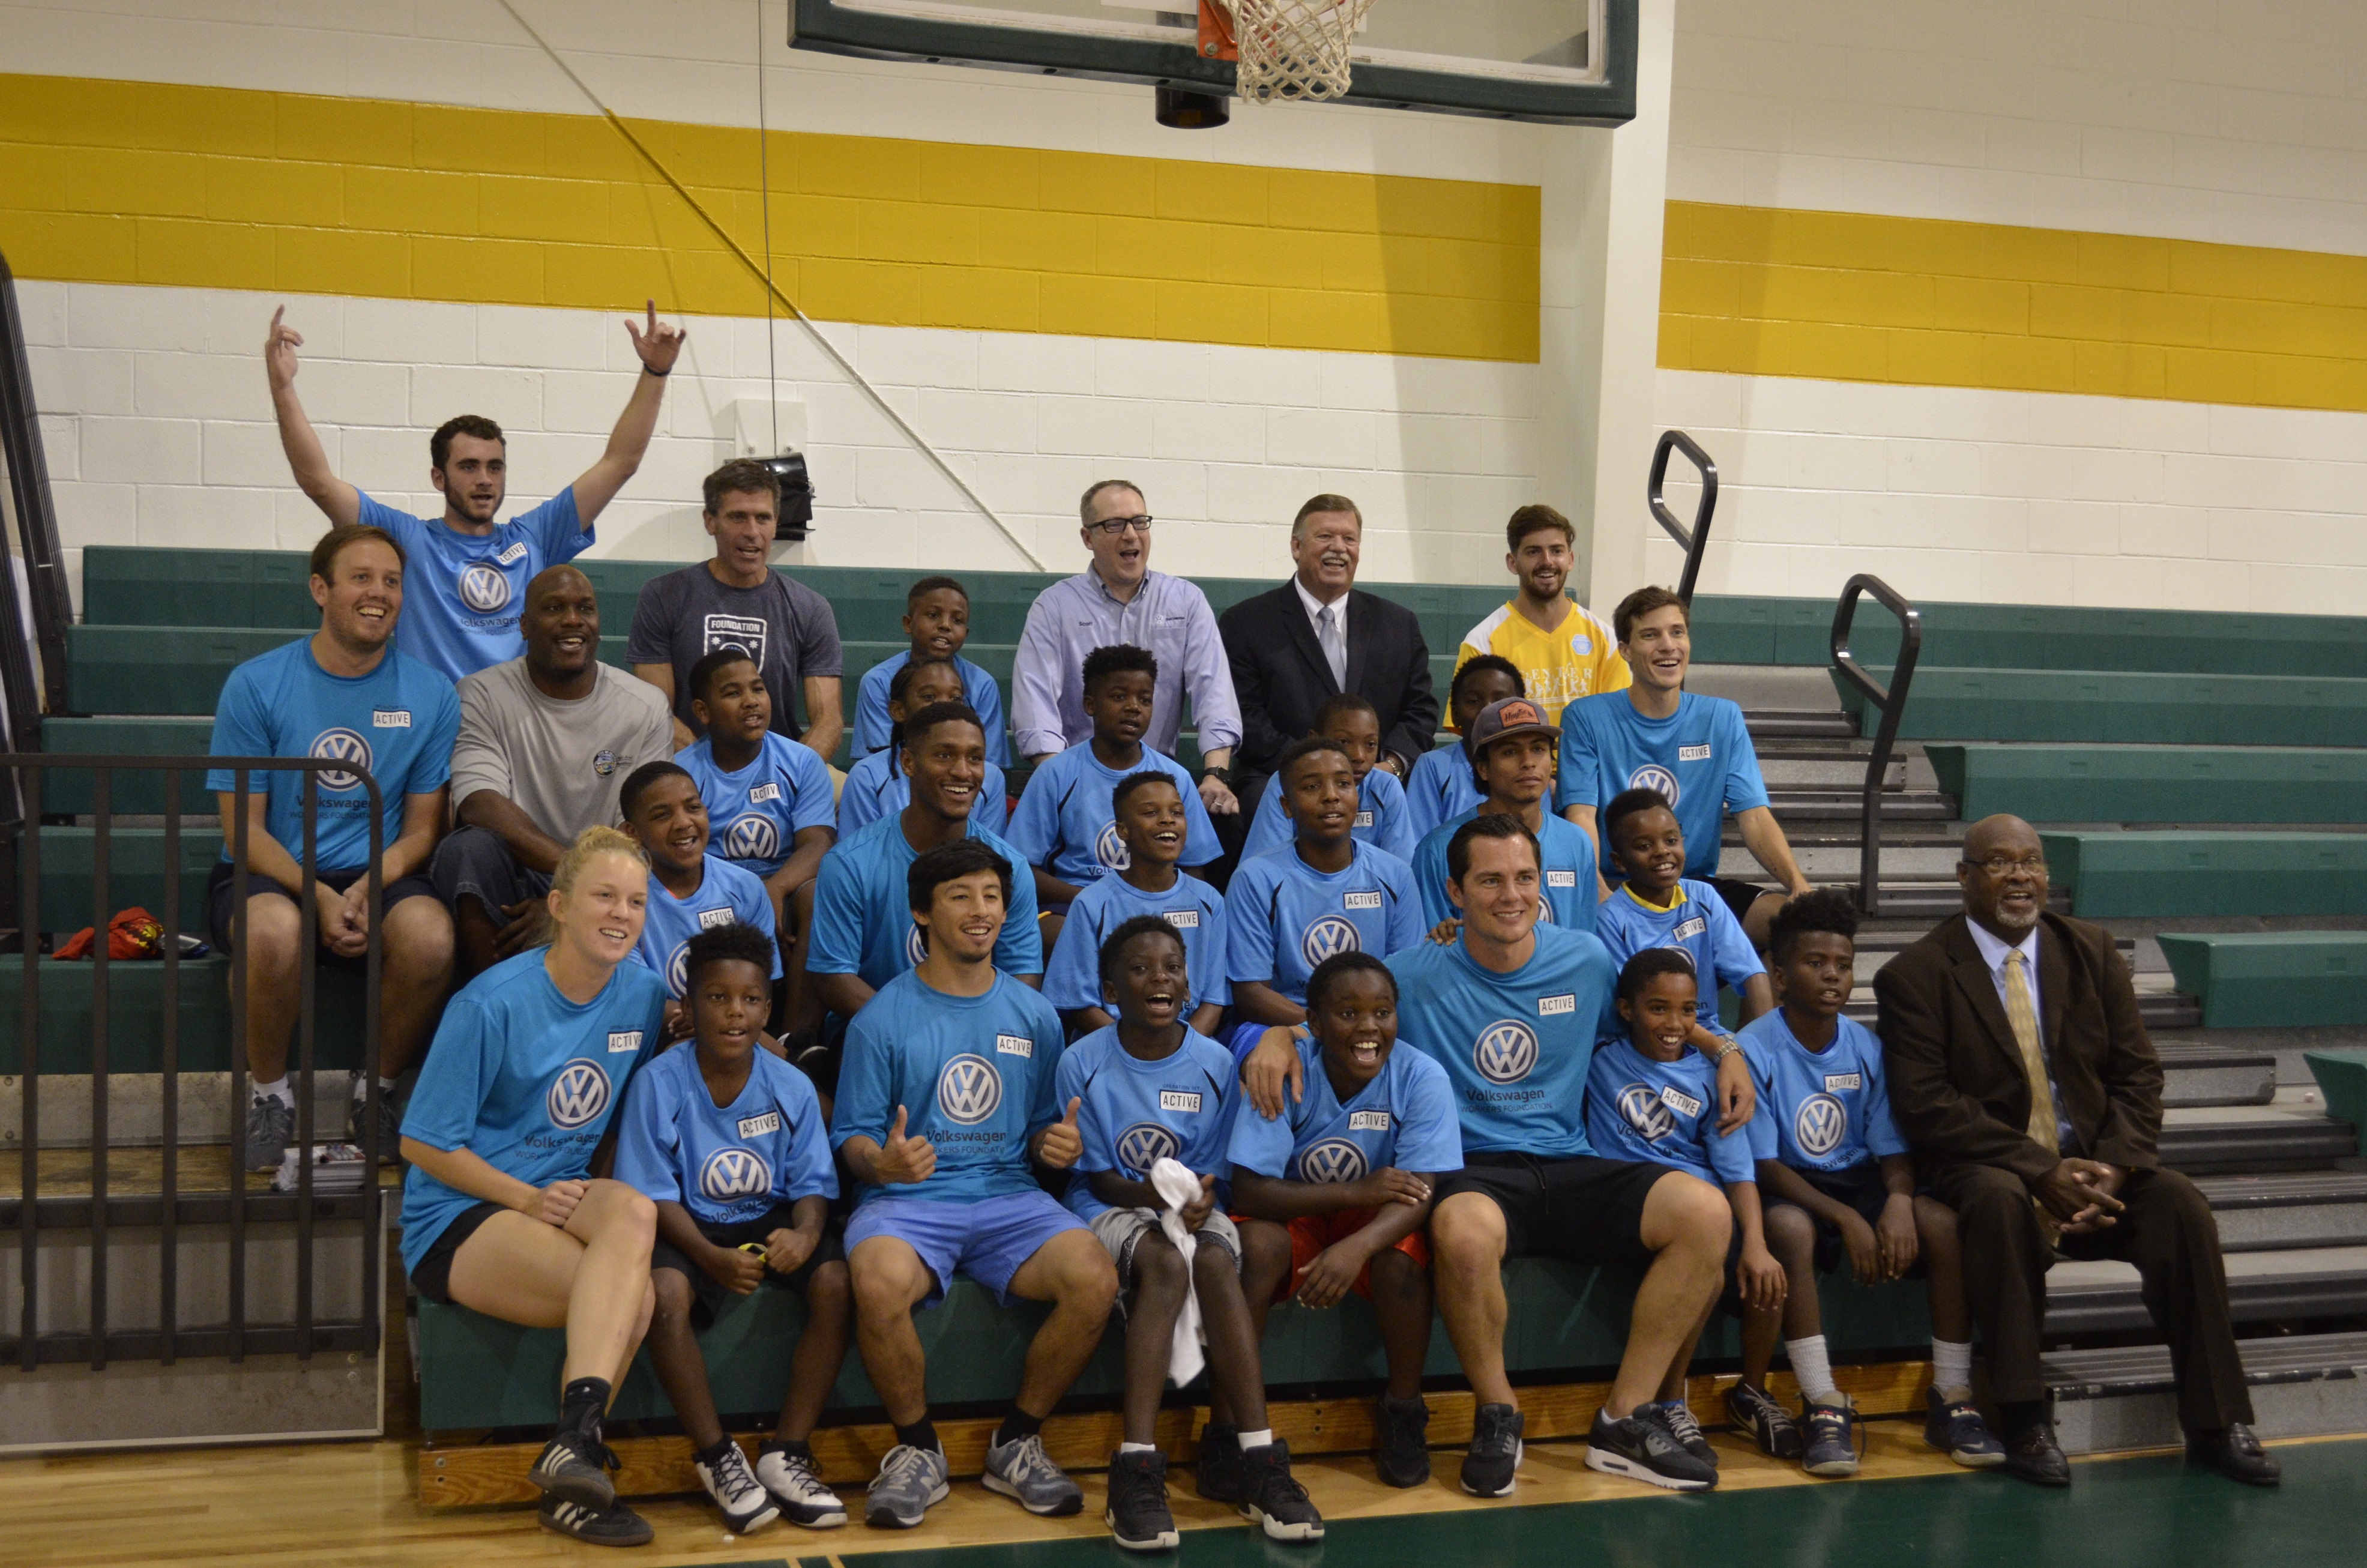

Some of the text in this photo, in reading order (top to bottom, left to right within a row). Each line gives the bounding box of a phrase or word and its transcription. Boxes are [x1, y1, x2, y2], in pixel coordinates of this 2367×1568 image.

[499, 544, 525, 563] ACTIVE
[711, 620, 760, 632] FOUNDATION
[376, 714, 408, 724] ACTIVE
[1681, 747, 1708, 758] ACTIVE
[297, 796, 370, 810] Vkswage
[1550, 874, 1573, 883] ACTIVE
[1348, 894, 1379, 905] ACTIVE
[704, 910, 733, 925] ACTIVE
[1166, 914, 1196, 924] ACTIVE
[1677, 920, 1704, 938] ACTIVE
[1542, 997, 1573, 1012] ACTIVE
[611, 1034, 642, 1048] ACTIVE
[1000, 1039, 1030, 1054] ACTIVE
[1829, 1076, 1859, 1088] ACTIVE
[1163, 1094, 1198, 1108] ACTIVE
[1466, 1090, 1545, 1103] Volkswagen
[1664, 1091, 1698, 1113] ACTIVE
[1503, 1102, 1552, 1112] FOUNDATION
[743, 1115, 777, 1134] ACTIVE
[1352, 1114, 1387, 1127] ACTIVE
[525, 1133, 600, 1148] Volkswagen
[926, 1130, 1006, 1144] Volkswagen
[711, 1200, 761, 1222] Volksw
